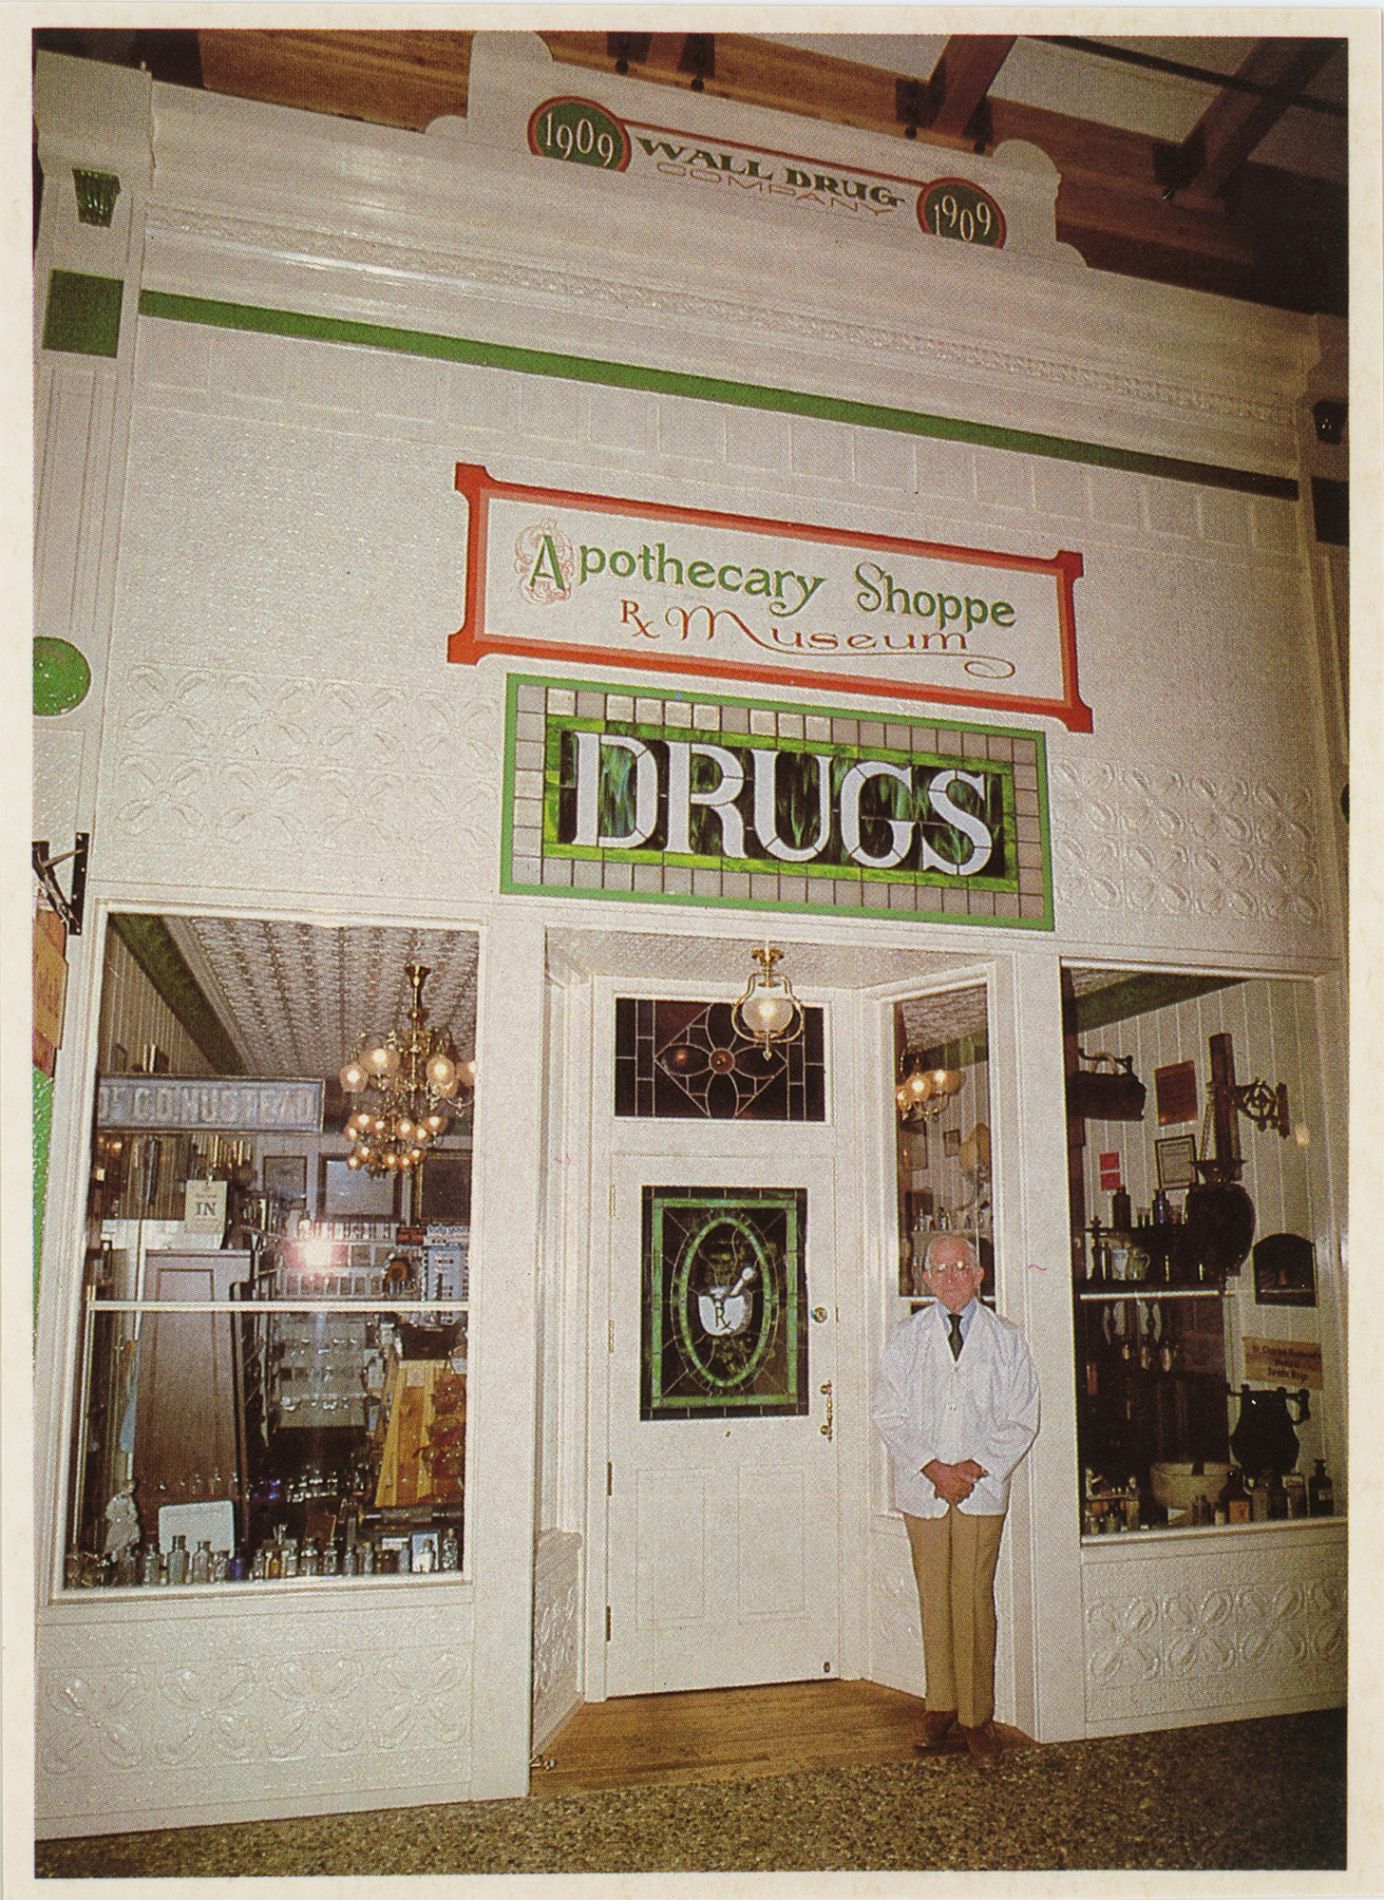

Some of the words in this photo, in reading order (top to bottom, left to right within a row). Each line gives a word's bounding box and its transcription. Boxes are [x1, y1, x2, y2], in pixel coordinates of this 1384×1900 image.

[546, 111, 614, 168] 1909
[635, 136, 774, 181] WALL
[784, 167, 906, 208] DRUG
[656, 161, 893, 216] COMPANY
[934, 194, 992, 242] 1909
[527, 534, 826, 617] Apothecary
[854, 561, 1017, 632] Shoppe
[665, 604, 1016, 679] Museum
[570, 730, 993, 877] DRUGS
[195, 1202, 217, 1217] IN
